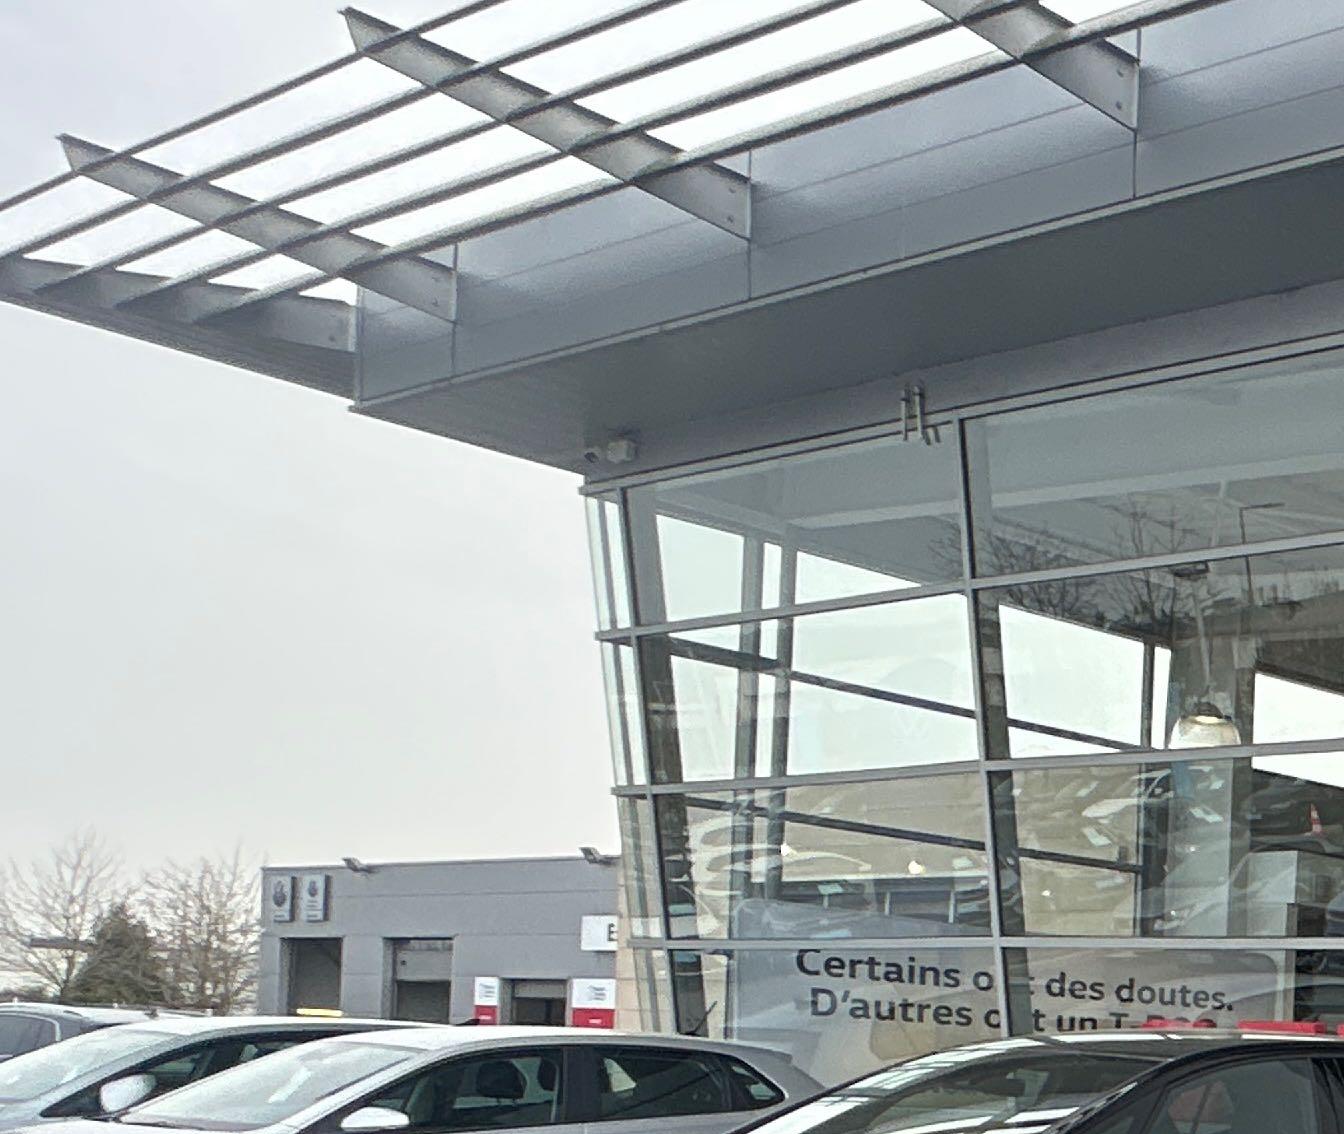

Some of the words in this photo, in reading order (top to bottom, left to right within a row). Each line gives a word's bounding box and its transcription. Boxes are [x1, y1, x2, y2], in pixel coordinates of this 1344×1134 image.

[796, 948, 960, 988] Certains
[1045, 971, 1105, 1001] des
[1114, 978, 1233, 1011] doutes.
[810, 987, 972, 1027] D'autres
[1057, 1014, 1098, 1032] un
